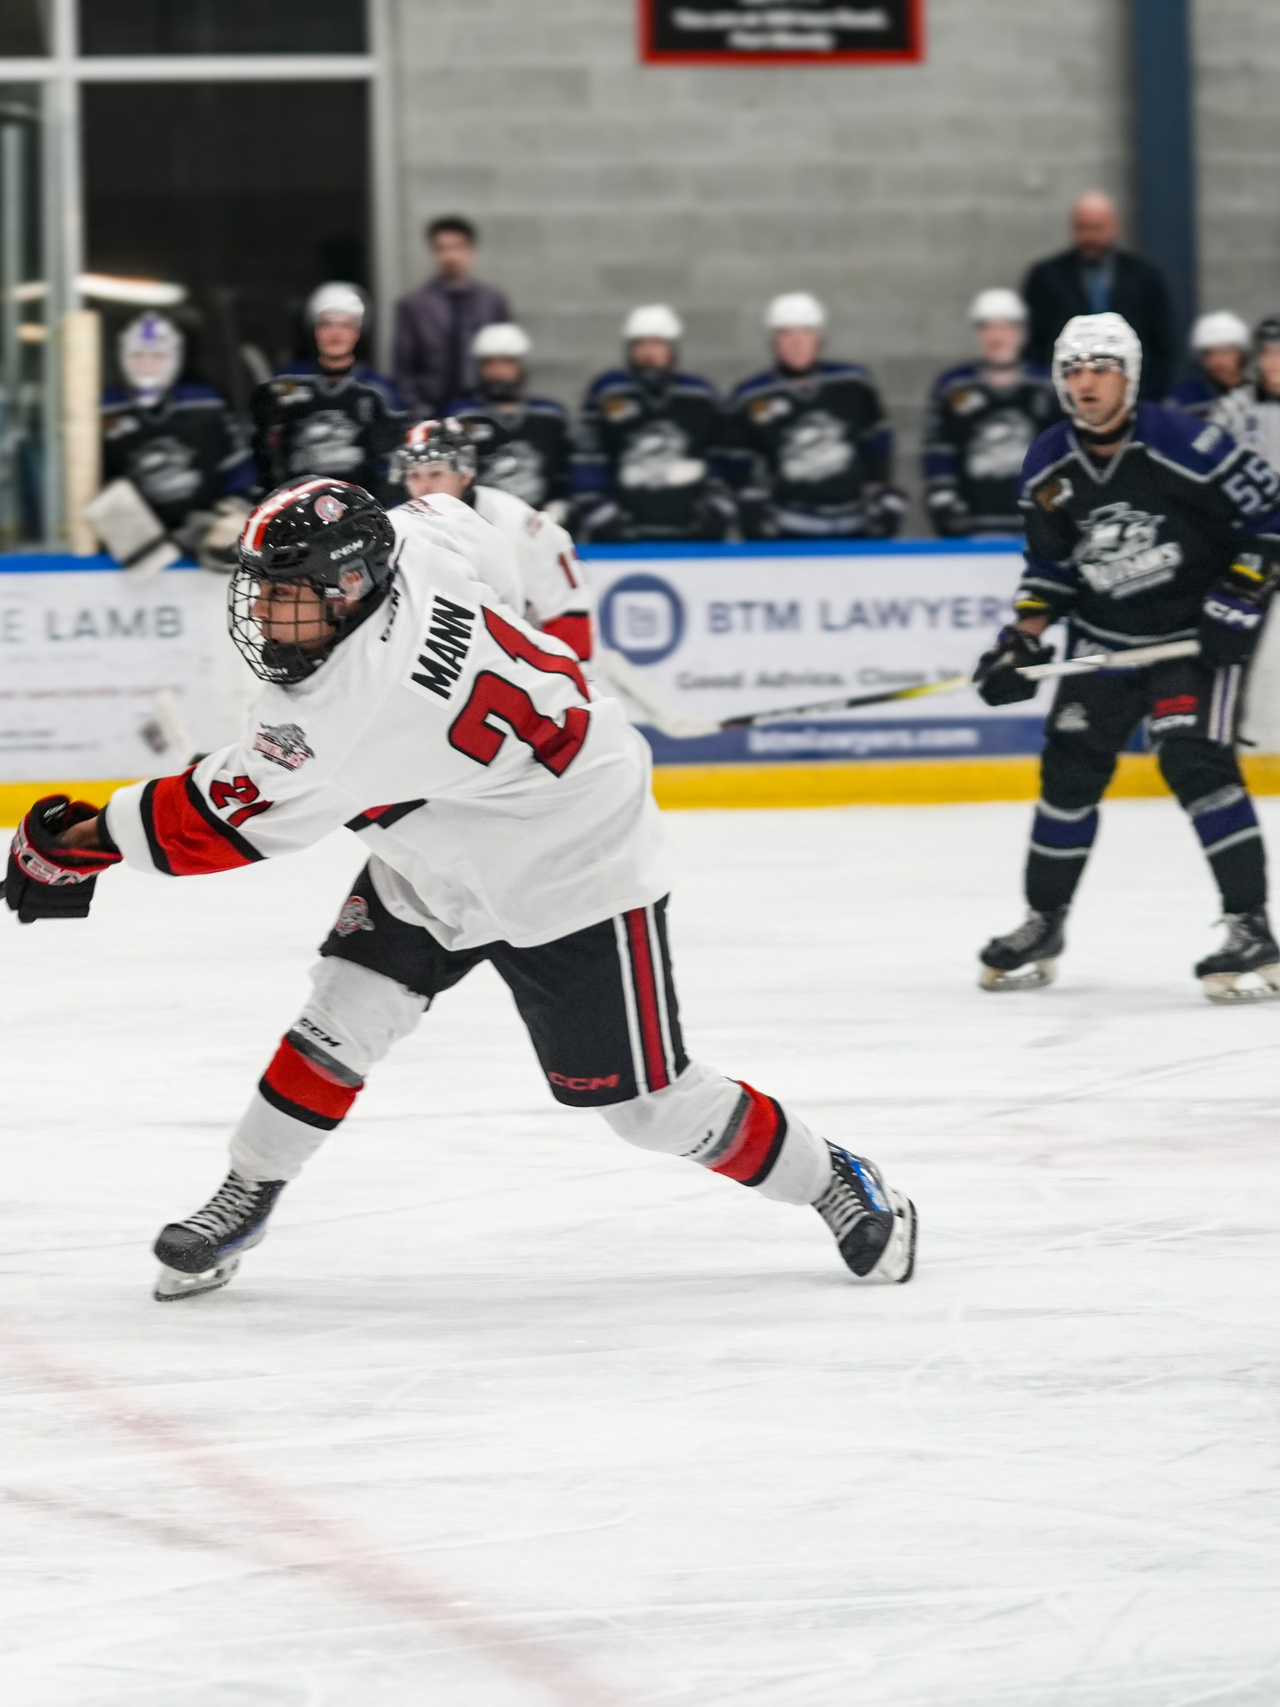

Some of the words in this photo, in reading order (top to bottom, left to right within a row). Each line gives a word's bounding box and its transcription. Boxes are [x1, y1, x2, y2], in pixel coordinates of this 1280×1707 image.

[44, 604, 184, 641] LAMB
[707, 599, 800, 634] BTM
[410, 594, 477, 701] MANN
[447, 603, 592, 779] 21
[209, 775, 275, 828] 21
[548, 1070, 621, 1091] CCM
